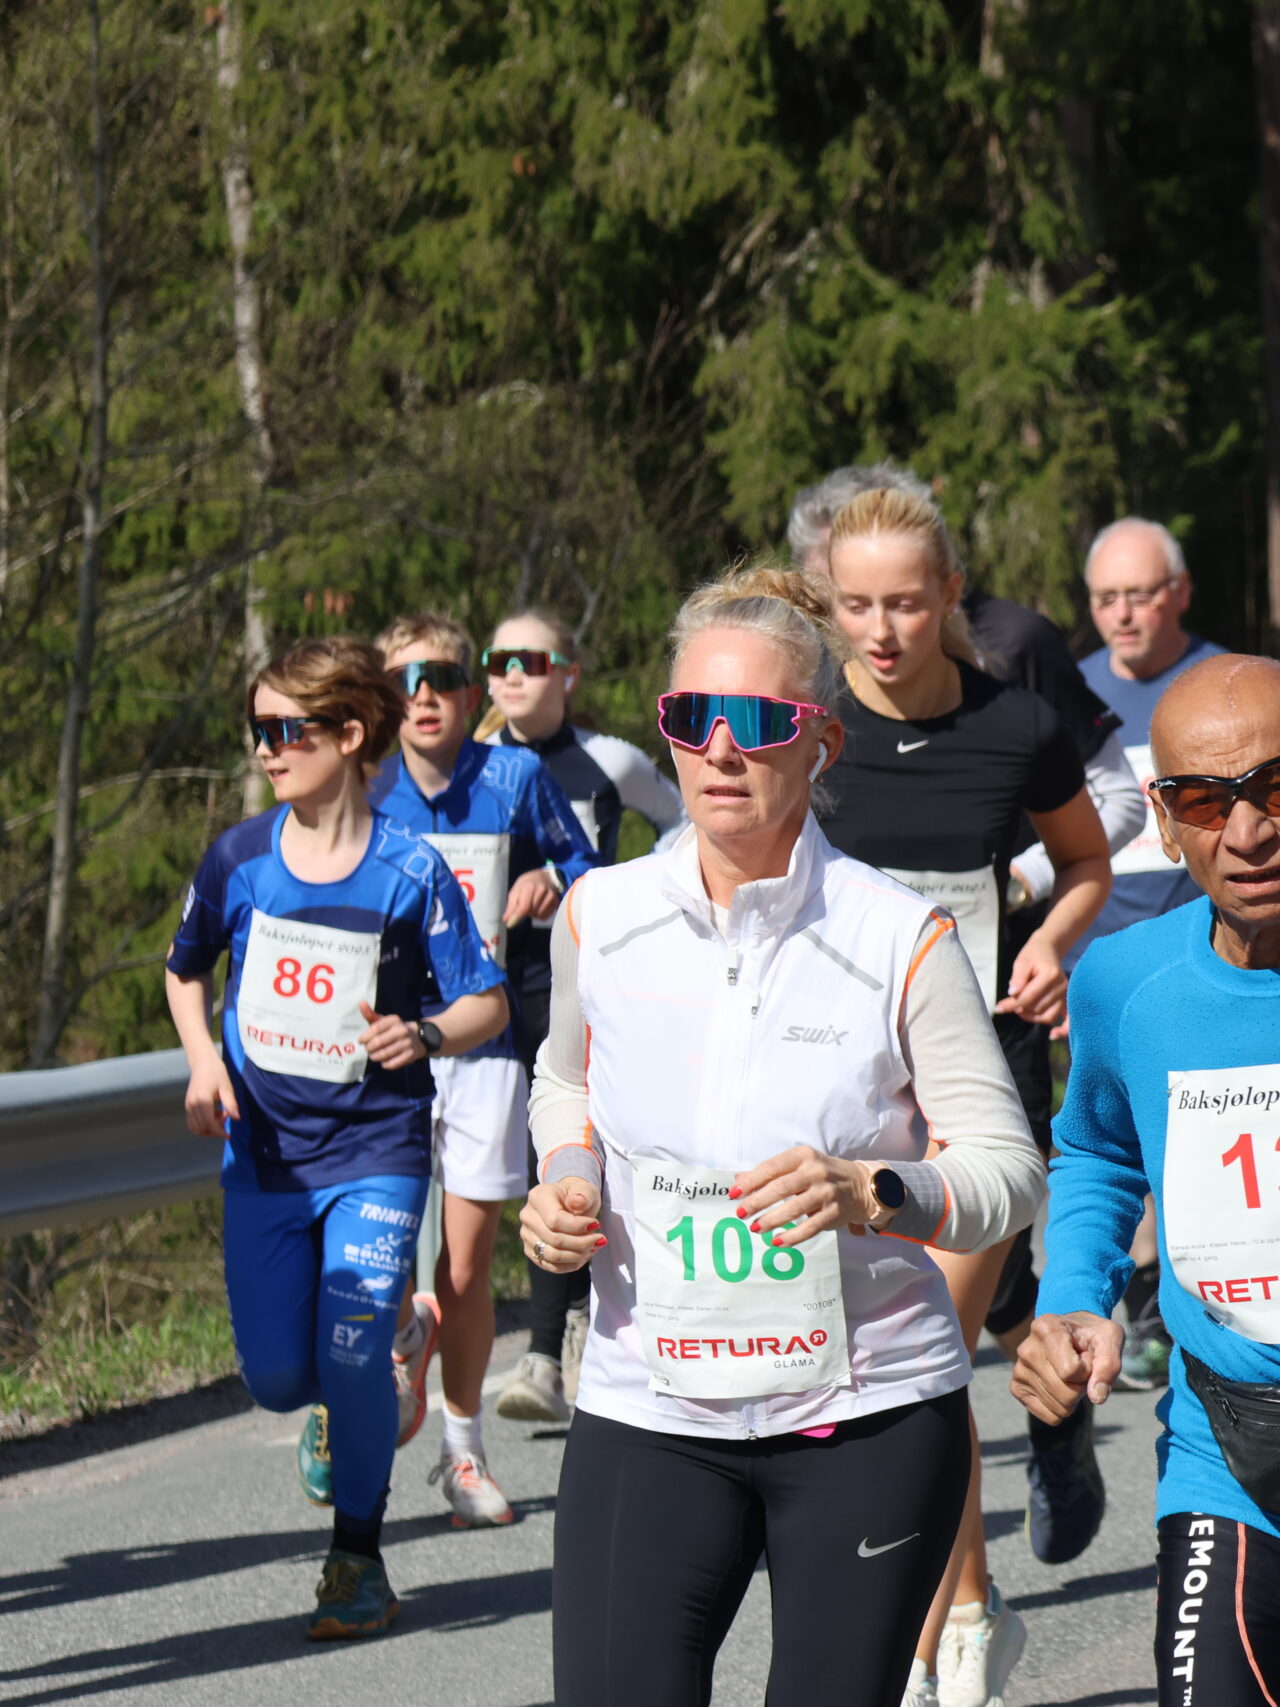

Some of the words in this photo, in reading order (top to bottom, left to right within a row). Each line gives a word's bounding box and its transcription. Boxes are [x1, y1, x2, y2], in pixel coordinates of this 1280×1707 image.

[273, 957, 336, 1004] 86
[247, 1024, 344, 1057] RETURA
[652, 1175, 729, 1201] Baksjølø
[666, 1216, 805, 1283] 108
[332, 1323, 363, 1349] EY
[657, 1335, 812, 1359] RETURA
